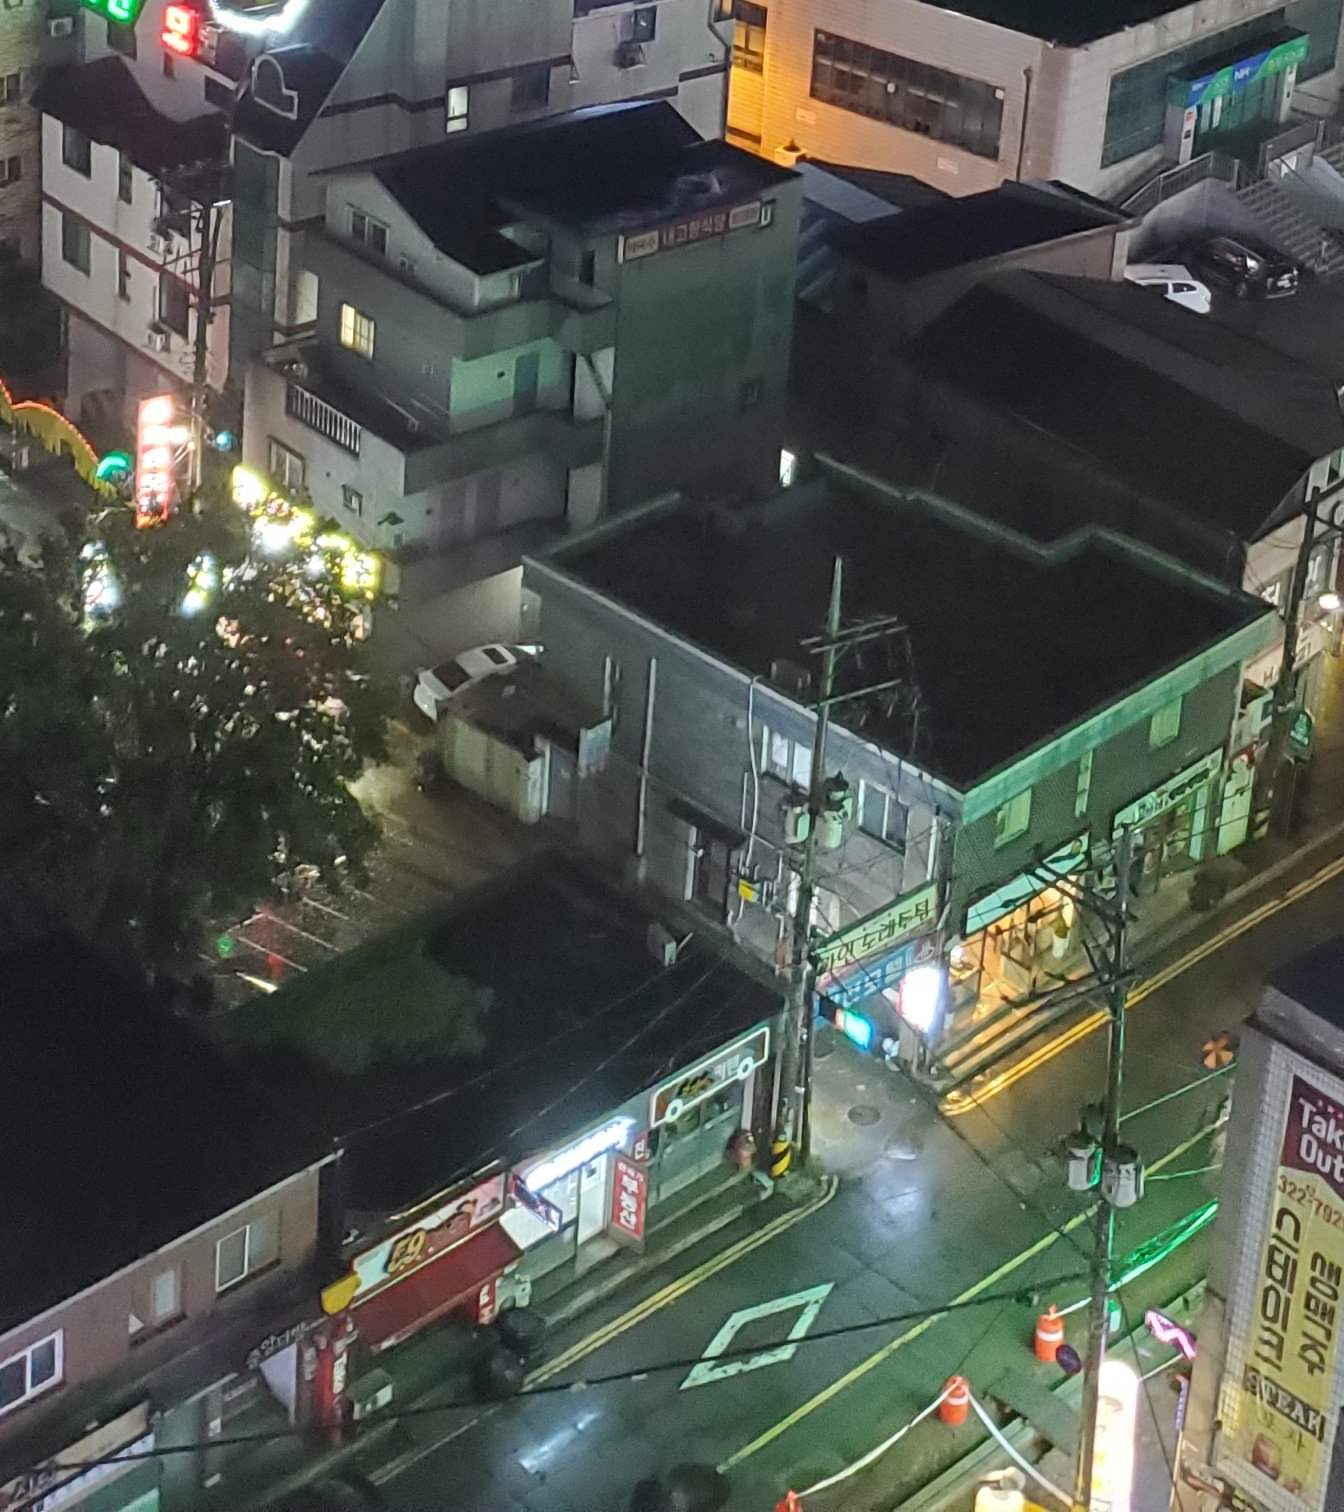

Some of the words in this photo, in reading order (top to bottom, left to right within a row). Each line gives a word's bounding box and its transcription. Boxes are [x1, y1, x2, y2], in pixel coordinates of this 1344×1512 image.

[662, 212, 727, 246] 내고향식당
[620, 1174, 640, 1230] 부동산
[1254, 1206, 1301, 1372] 스테이크
[1297, 1251, 1343, 1376] 생맥주
[1245, 1367, 1324, 1440] STEAK
